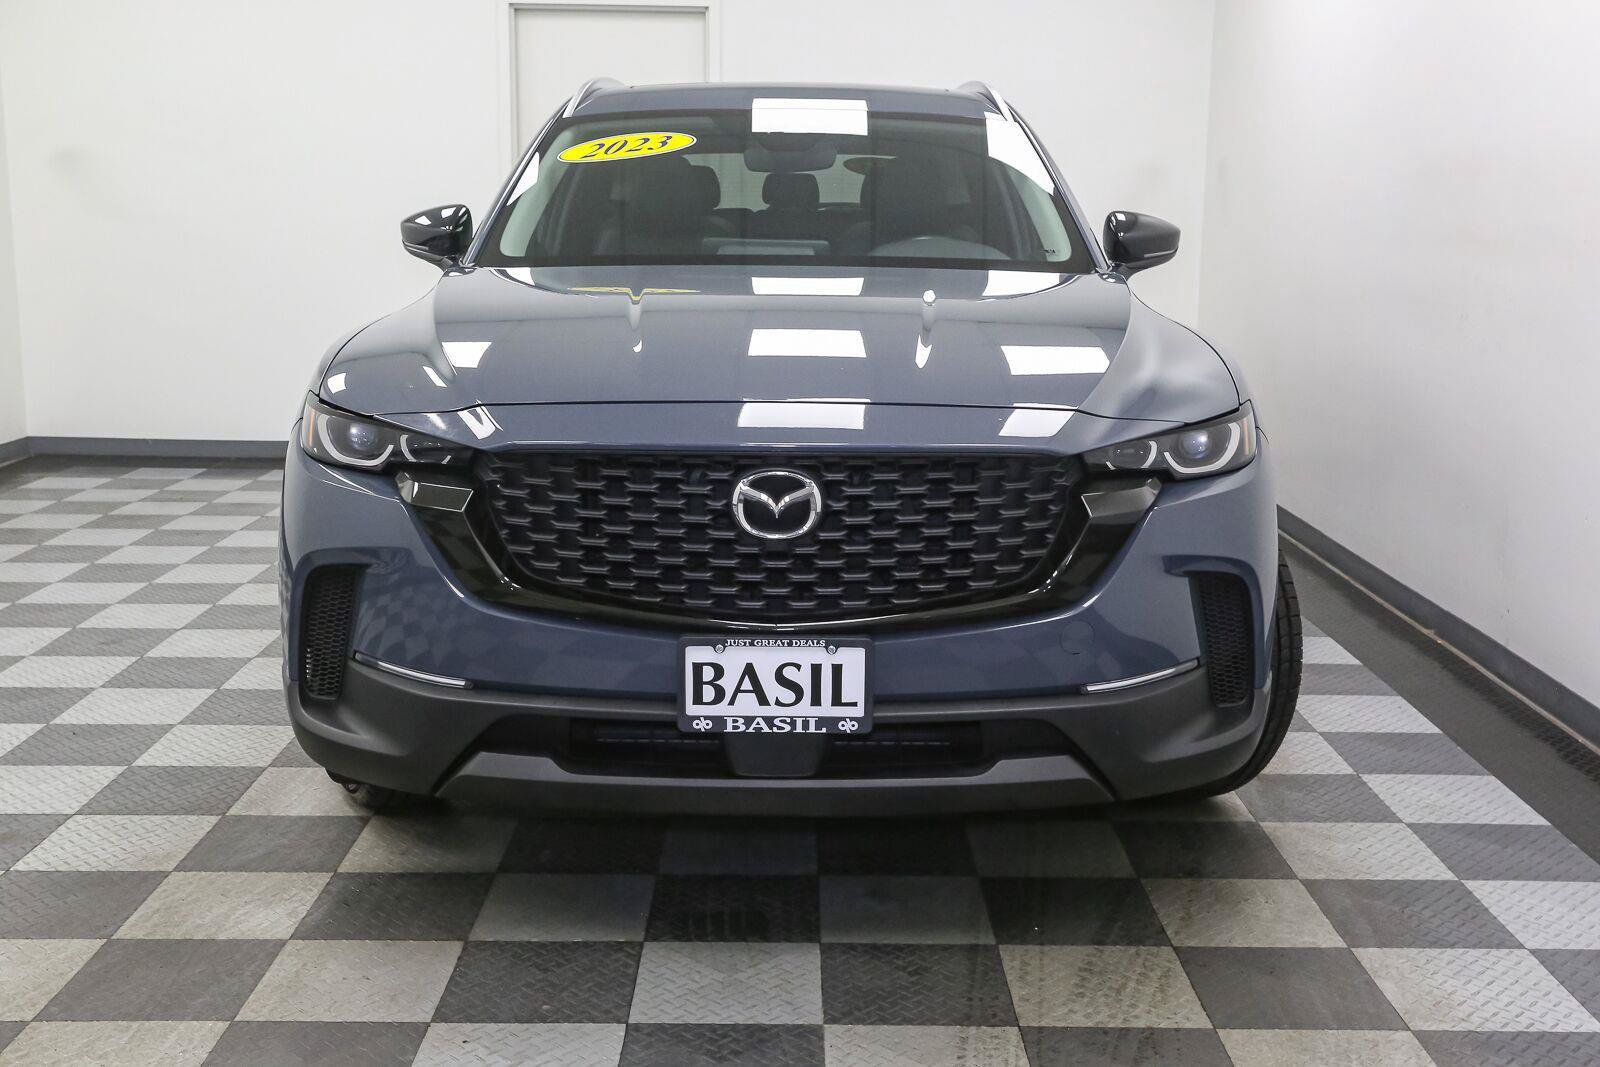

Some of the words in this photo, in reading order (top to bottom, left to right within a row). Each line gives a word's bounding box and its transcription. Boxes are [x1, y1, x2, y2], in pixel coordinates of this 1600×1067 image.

[580, 135, 673, 159] 2023
[725, 639, 751, 647] JUST
[754, 639, 790, 647] GREAT
[792, 639, 826, 647] DEALS
[691, 662, 858, 707] BASIL
[723, 716, 827, 733] BASIL
